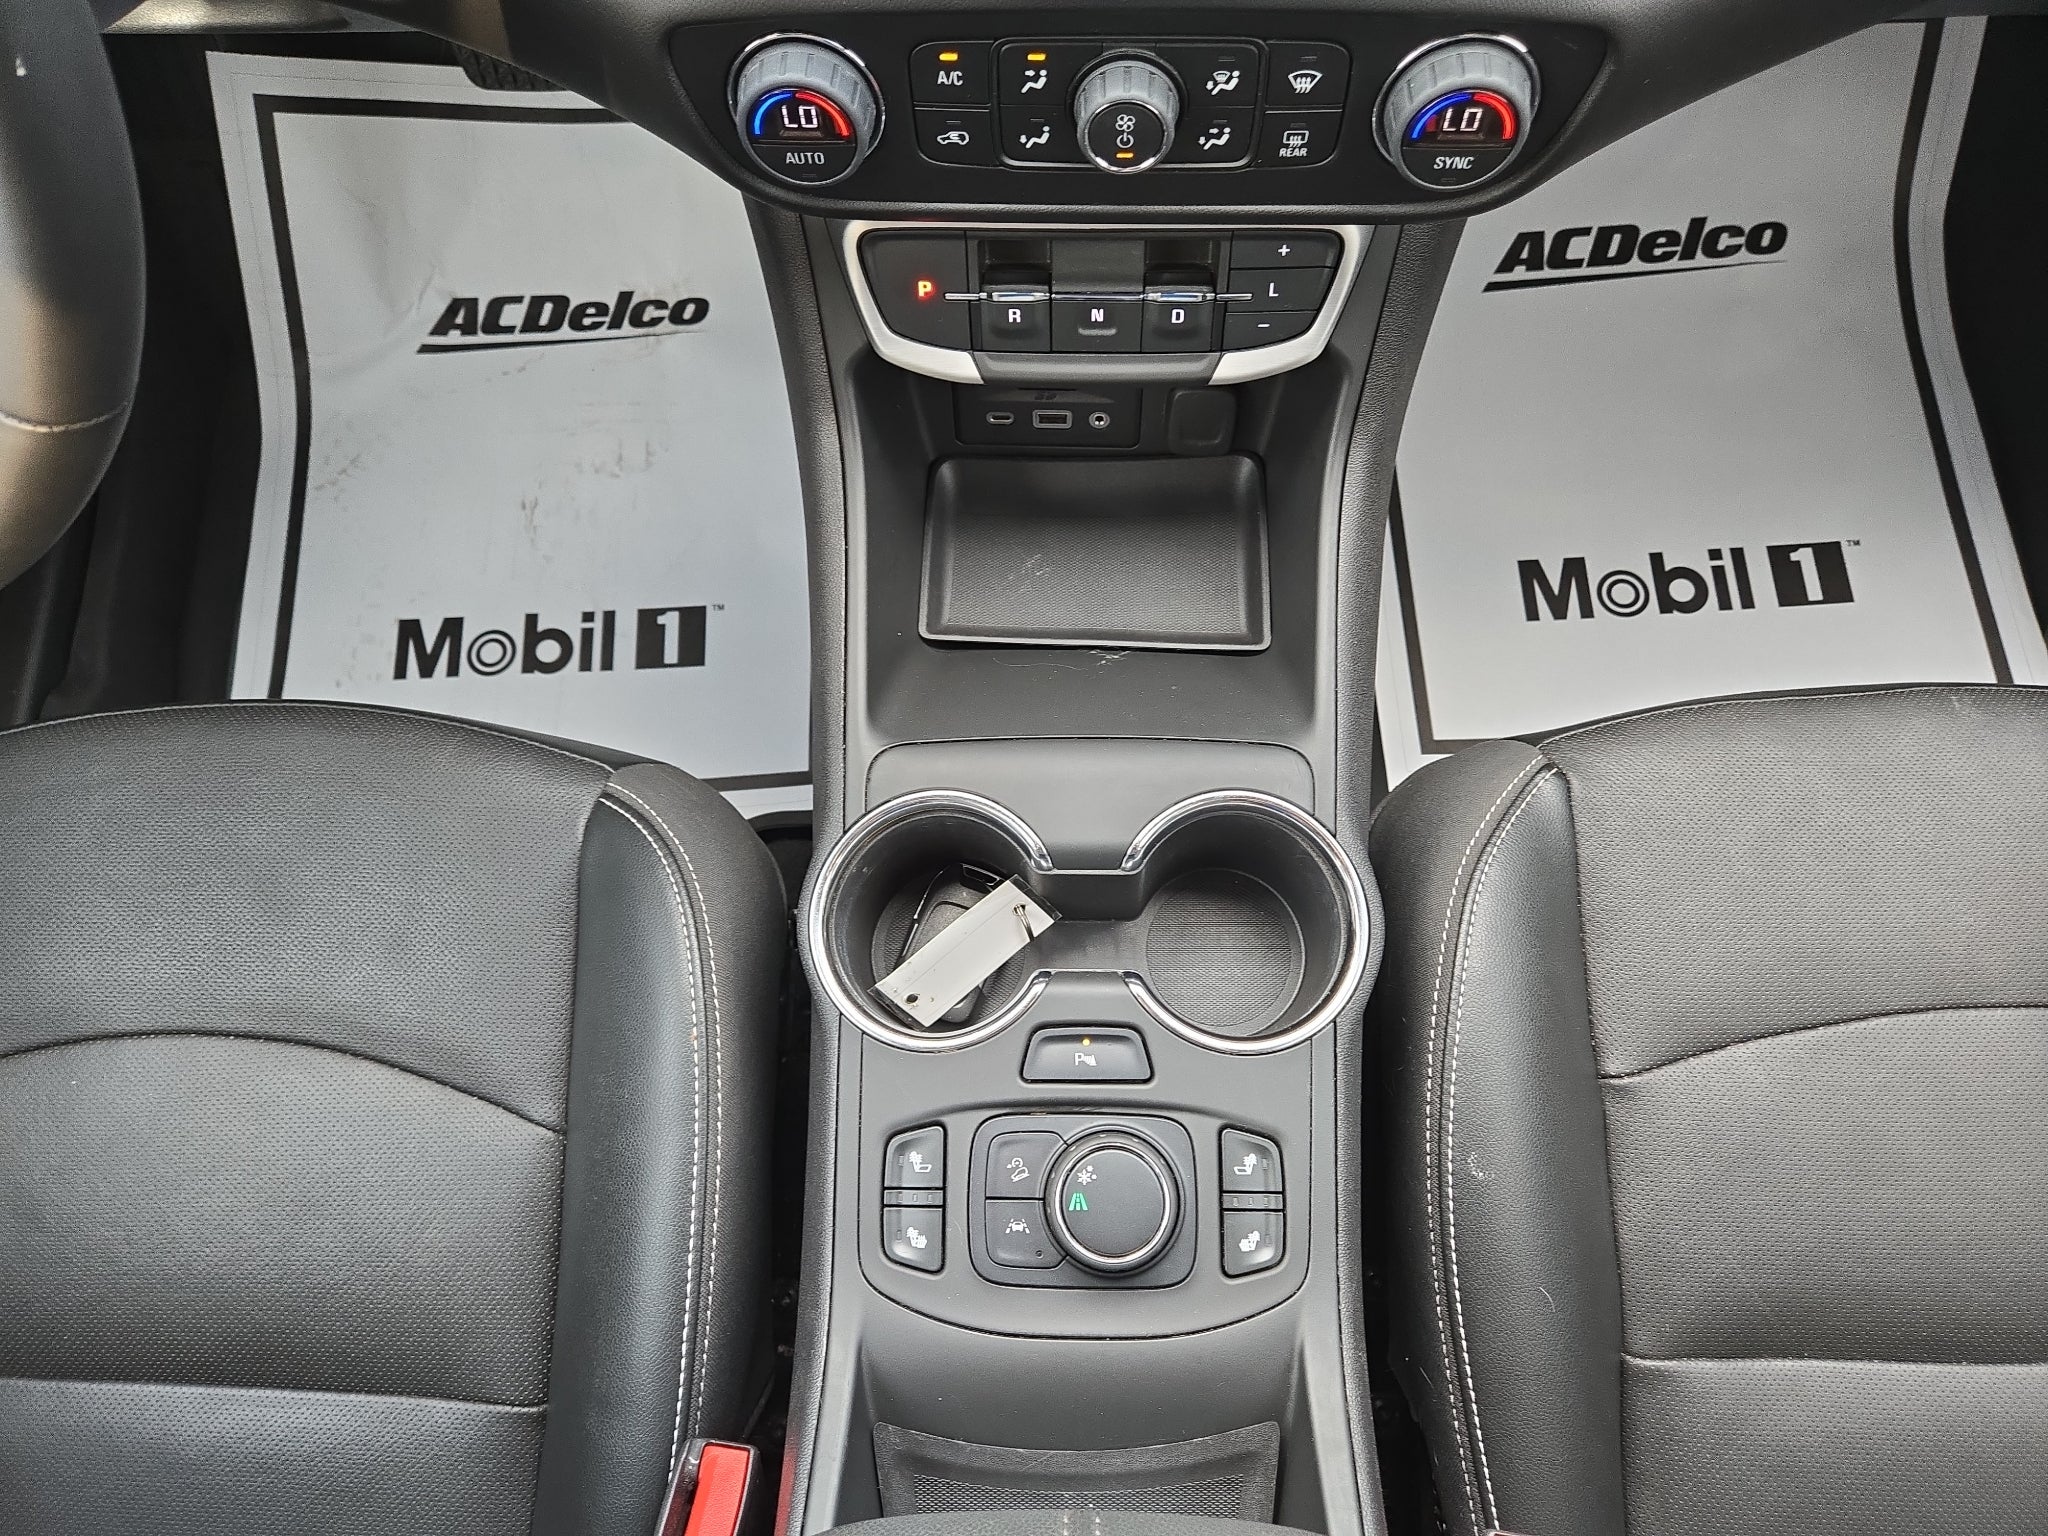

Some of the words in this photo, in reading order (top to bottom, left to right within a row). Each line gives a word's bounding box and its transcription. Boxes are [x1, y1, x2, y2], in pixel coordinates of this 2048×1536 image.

[937, 70, 964, 86] A/C
[785, 152, 825, 165] AUTO
[1279, 147, 1308, 157] REAR
[1433, 156, 1475, 170] SYNC
[1493, 216, 1788, 275] ACDelco
[917, 280, 934, 298] P
[1268, 282, 1280, 298] L
[428, 291, 710, 336] ACDelco
[1008, 308, 1022, 323] R
[1090, 308, 1104, 323] N
[1171, 308, 1185, 324] D
[1517, 546, 1756, 622] Mobil
[393, 610, 616, 680] Mobil
